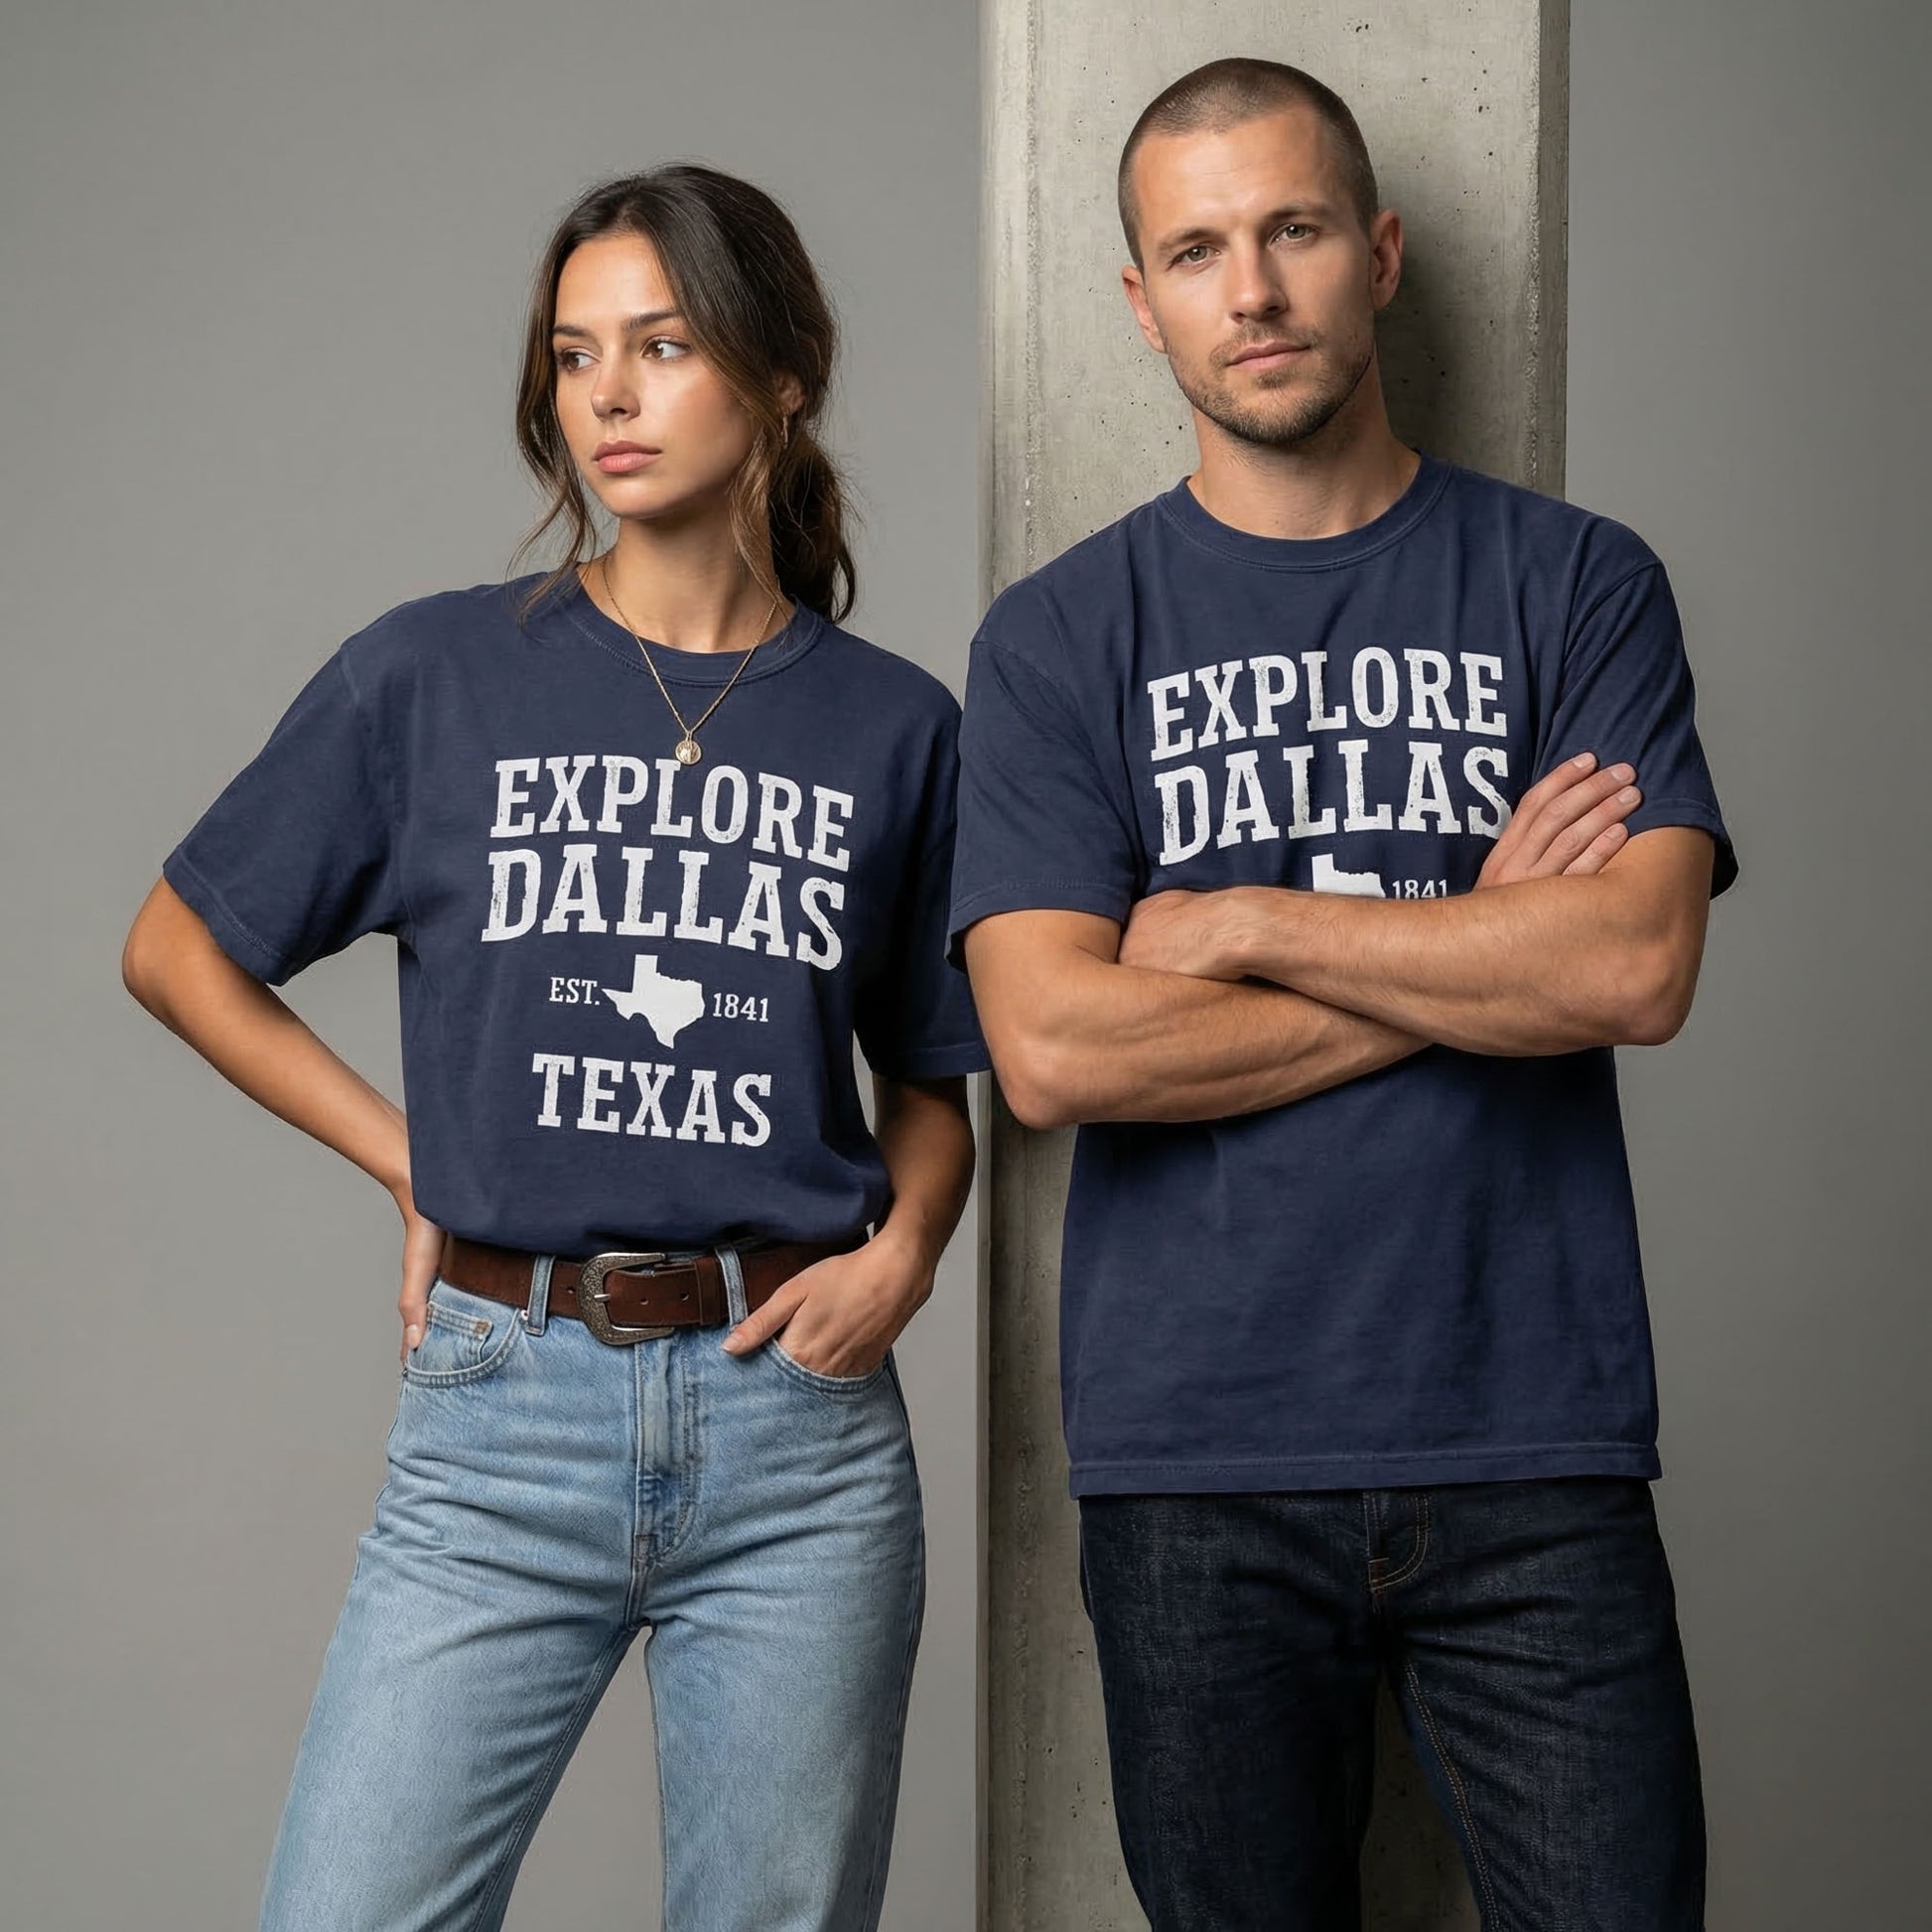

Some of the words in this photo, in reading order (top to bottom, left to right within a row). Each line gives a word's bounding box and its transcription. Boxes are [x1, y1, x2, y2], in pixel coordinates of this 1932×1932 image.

[1148, 646, 1508, 761] EXPLORE
[489, 755, 854, 873] EXPLORE
[1155, 740, 1513, 866] DALLAS
[481, 843, 845, 971] DALLAS
[1392, 879, 1448, 899] 1841
[549, 977, 601, 1006] EST.
[712, 992, 769, 1023] 1841
[531, 1052, 772, 1148] TEXAS
